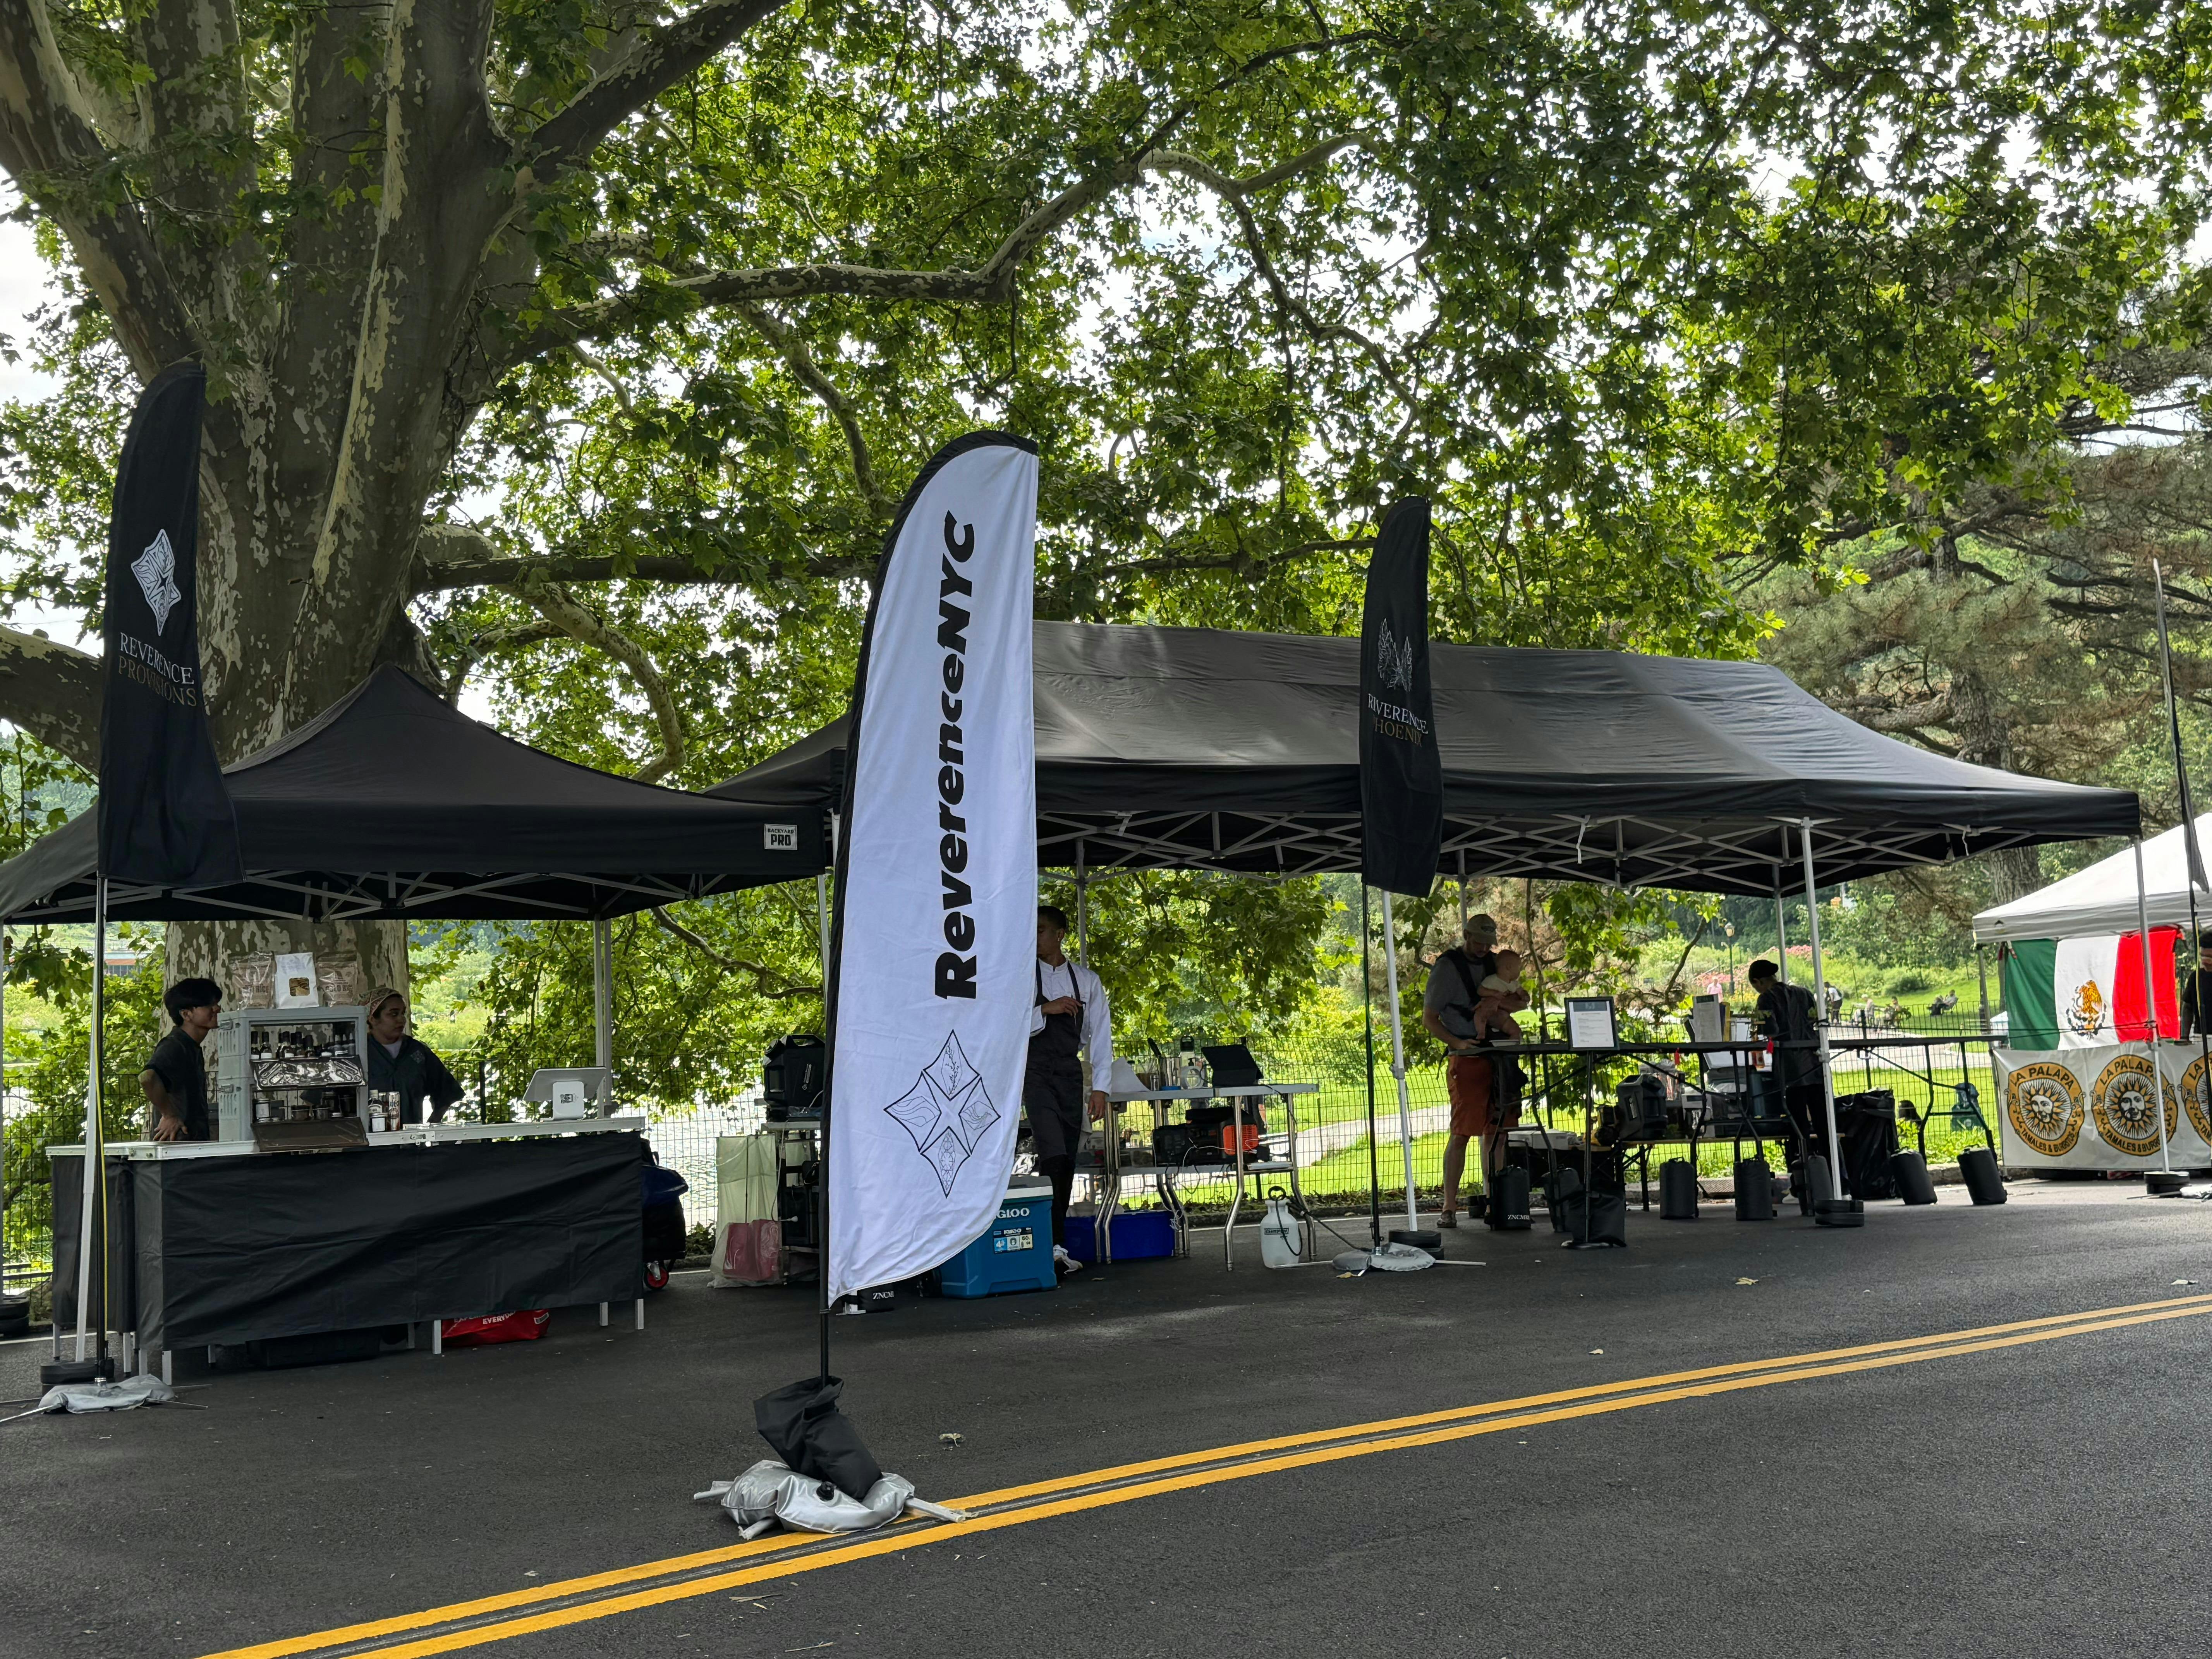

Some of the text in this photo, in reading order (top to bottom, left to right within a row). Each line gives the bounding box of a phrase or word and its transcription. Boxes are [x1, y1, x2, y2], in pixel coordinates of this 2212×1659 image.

[119, 631, 194, 685] REVERENCE
[118, 655, 197, 707] PROVISIONS
[1373, 714, 1422, 747] HOENIX
[934, 510, 977, 1000] ReverenceNYC
[771, 834, 792, 846] PRO
[2010, 1065, 2074, 1090] LA PALAPA
[2099, 1068, 2114, 1085] LA
[2189, 1063, 2203, 1080] LA
[2021, 1128, 2047, 1152] TAMALES
[2048, 1144, 2052, 1152] &
[2105, 1130, 2136, 1152] TAMALES
[996, 1207, 1030, 1219] GLOO
